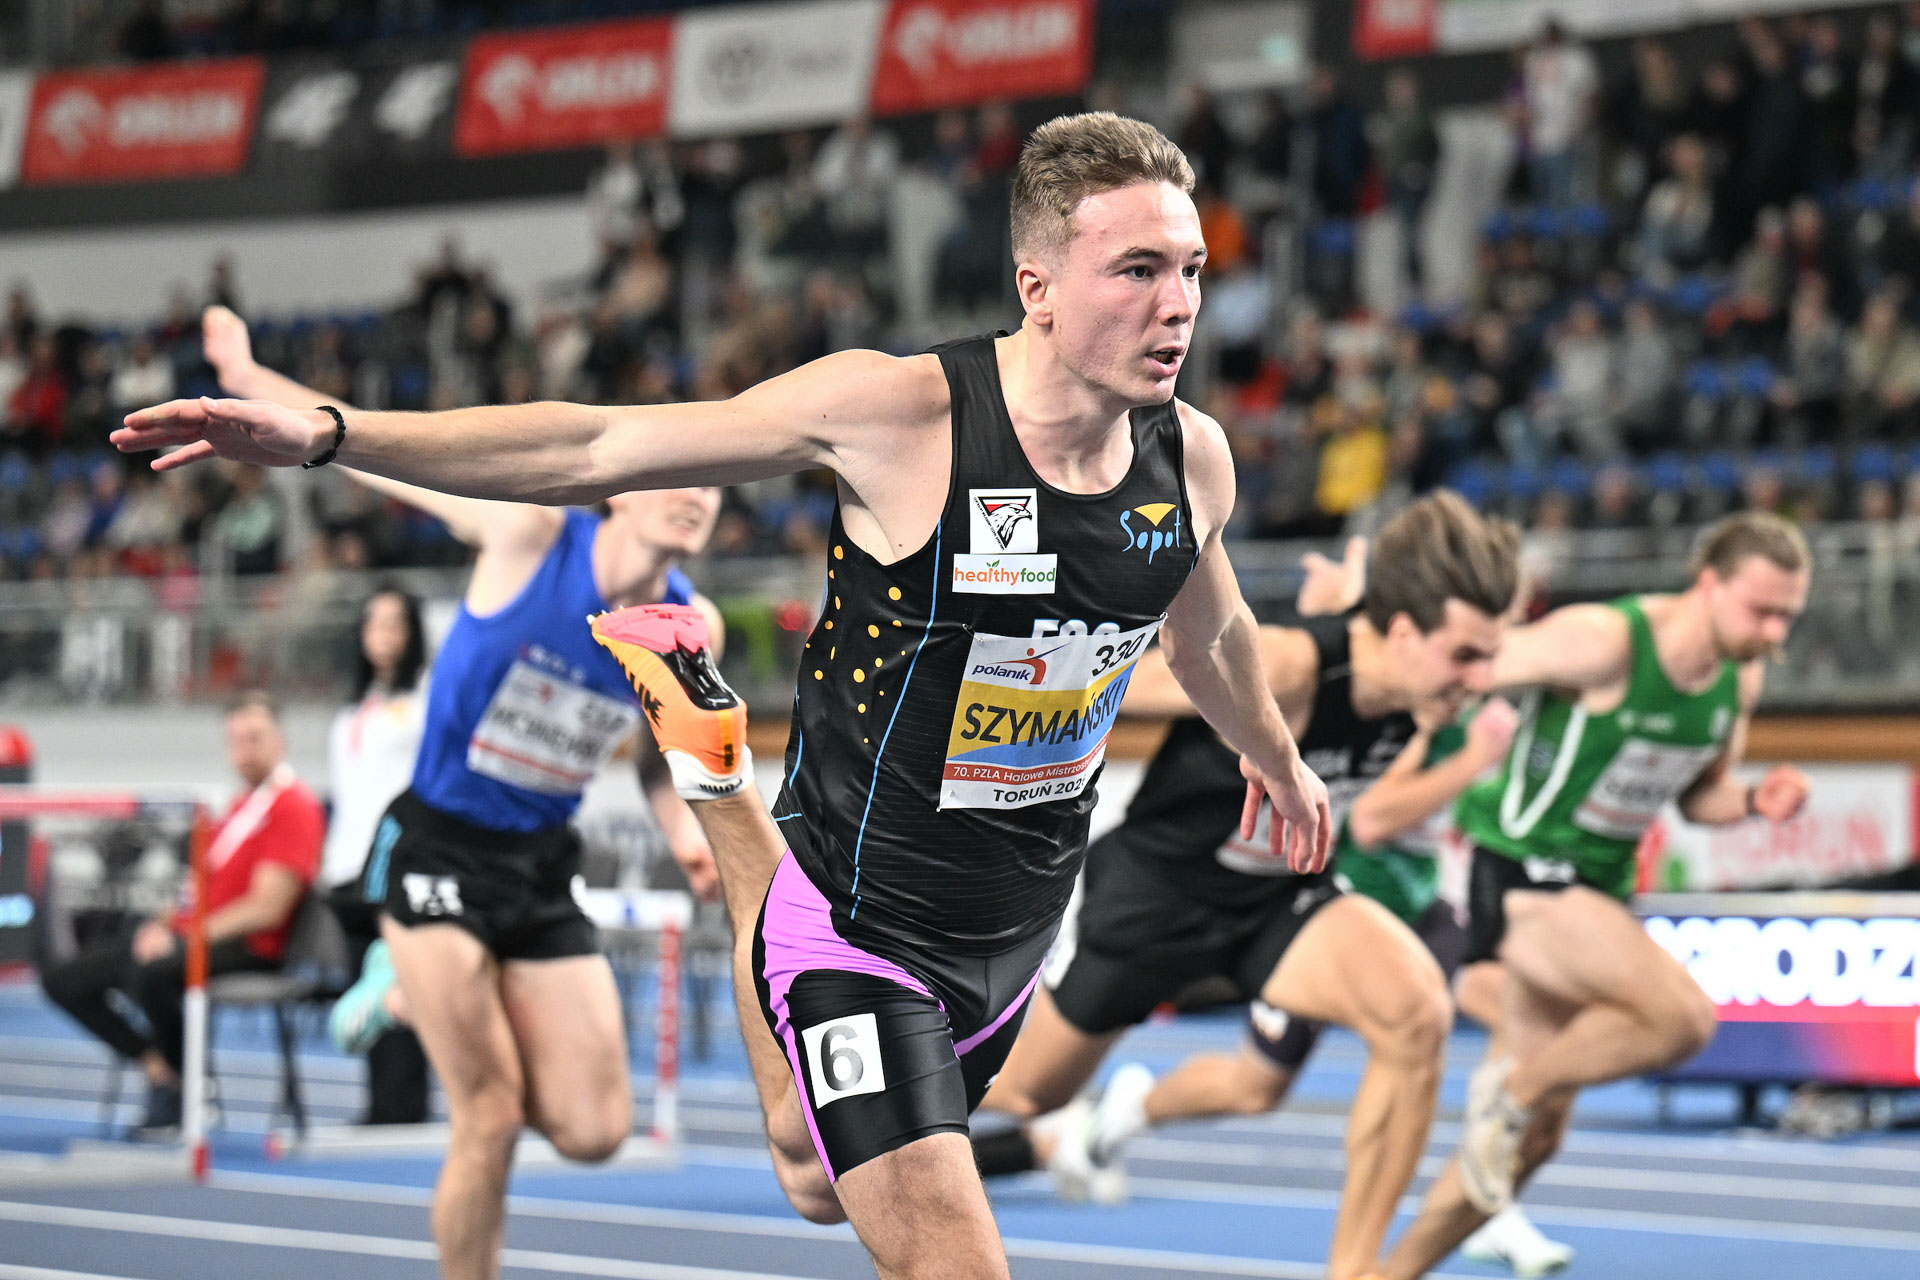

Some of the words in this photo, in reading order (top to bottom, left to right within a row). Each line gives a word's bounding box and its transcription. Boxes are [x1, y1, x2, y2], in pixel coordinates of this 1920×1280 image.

[1120, 510, 1181, 565] Sopot
[954, 566, 1055, 586] healthyfood
[1092, 632, 1146, 676] 330
[972, 663, 1031, 681] polanik
[960, 679, 1123, 747] SZYMAŃSKI
[953, 767, 970, 778] 70.
[973, 768, 1000, 780] PZLA
[1004, 770, 1045, 782] Halowe
[993, 782, 1051, 803] TORUŃ
[821, 1025, 864, 1091] 6
